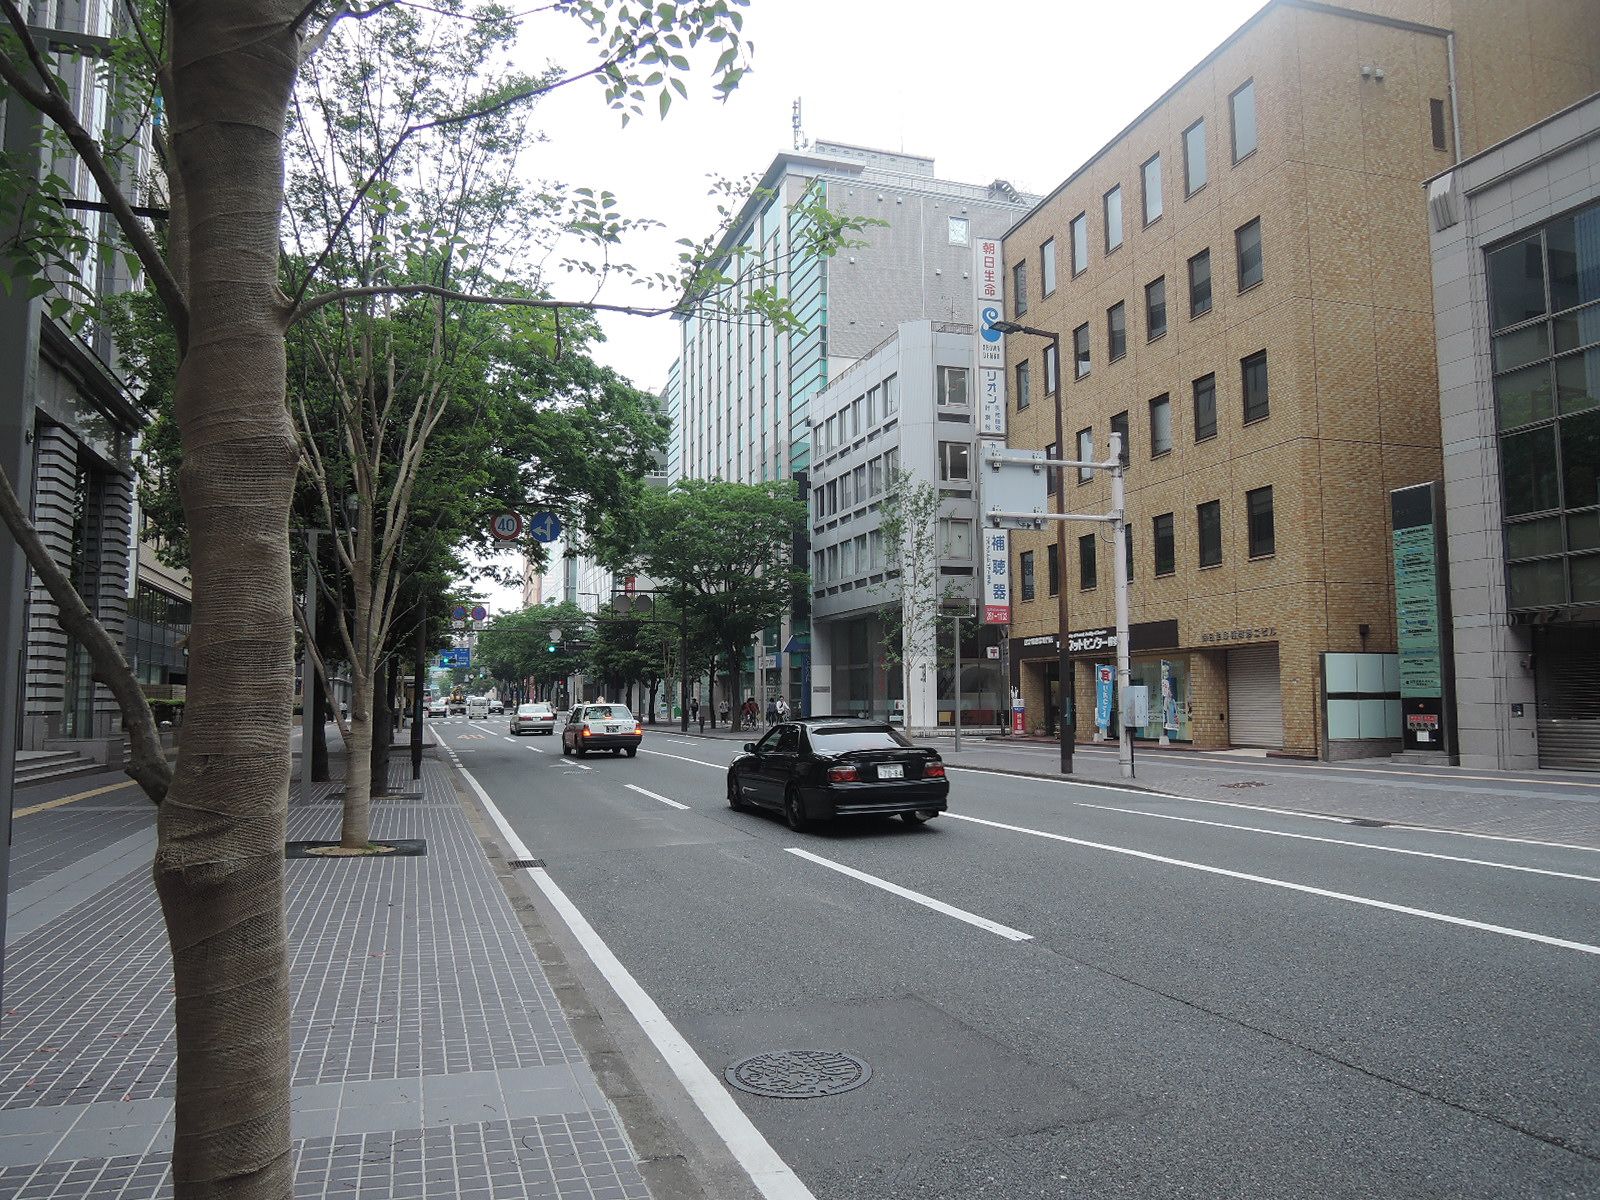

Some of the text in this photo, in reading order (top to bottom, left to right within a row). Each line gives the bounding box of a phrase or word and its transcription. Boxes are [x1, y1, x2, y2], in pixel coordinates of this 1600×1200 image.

[983, 242, 996, 296] 朝日生命
[987, 371, 997, 403] リオン
[498, 518, 515, 531] 40
[991, 535, 1006, 600] 補聴器
